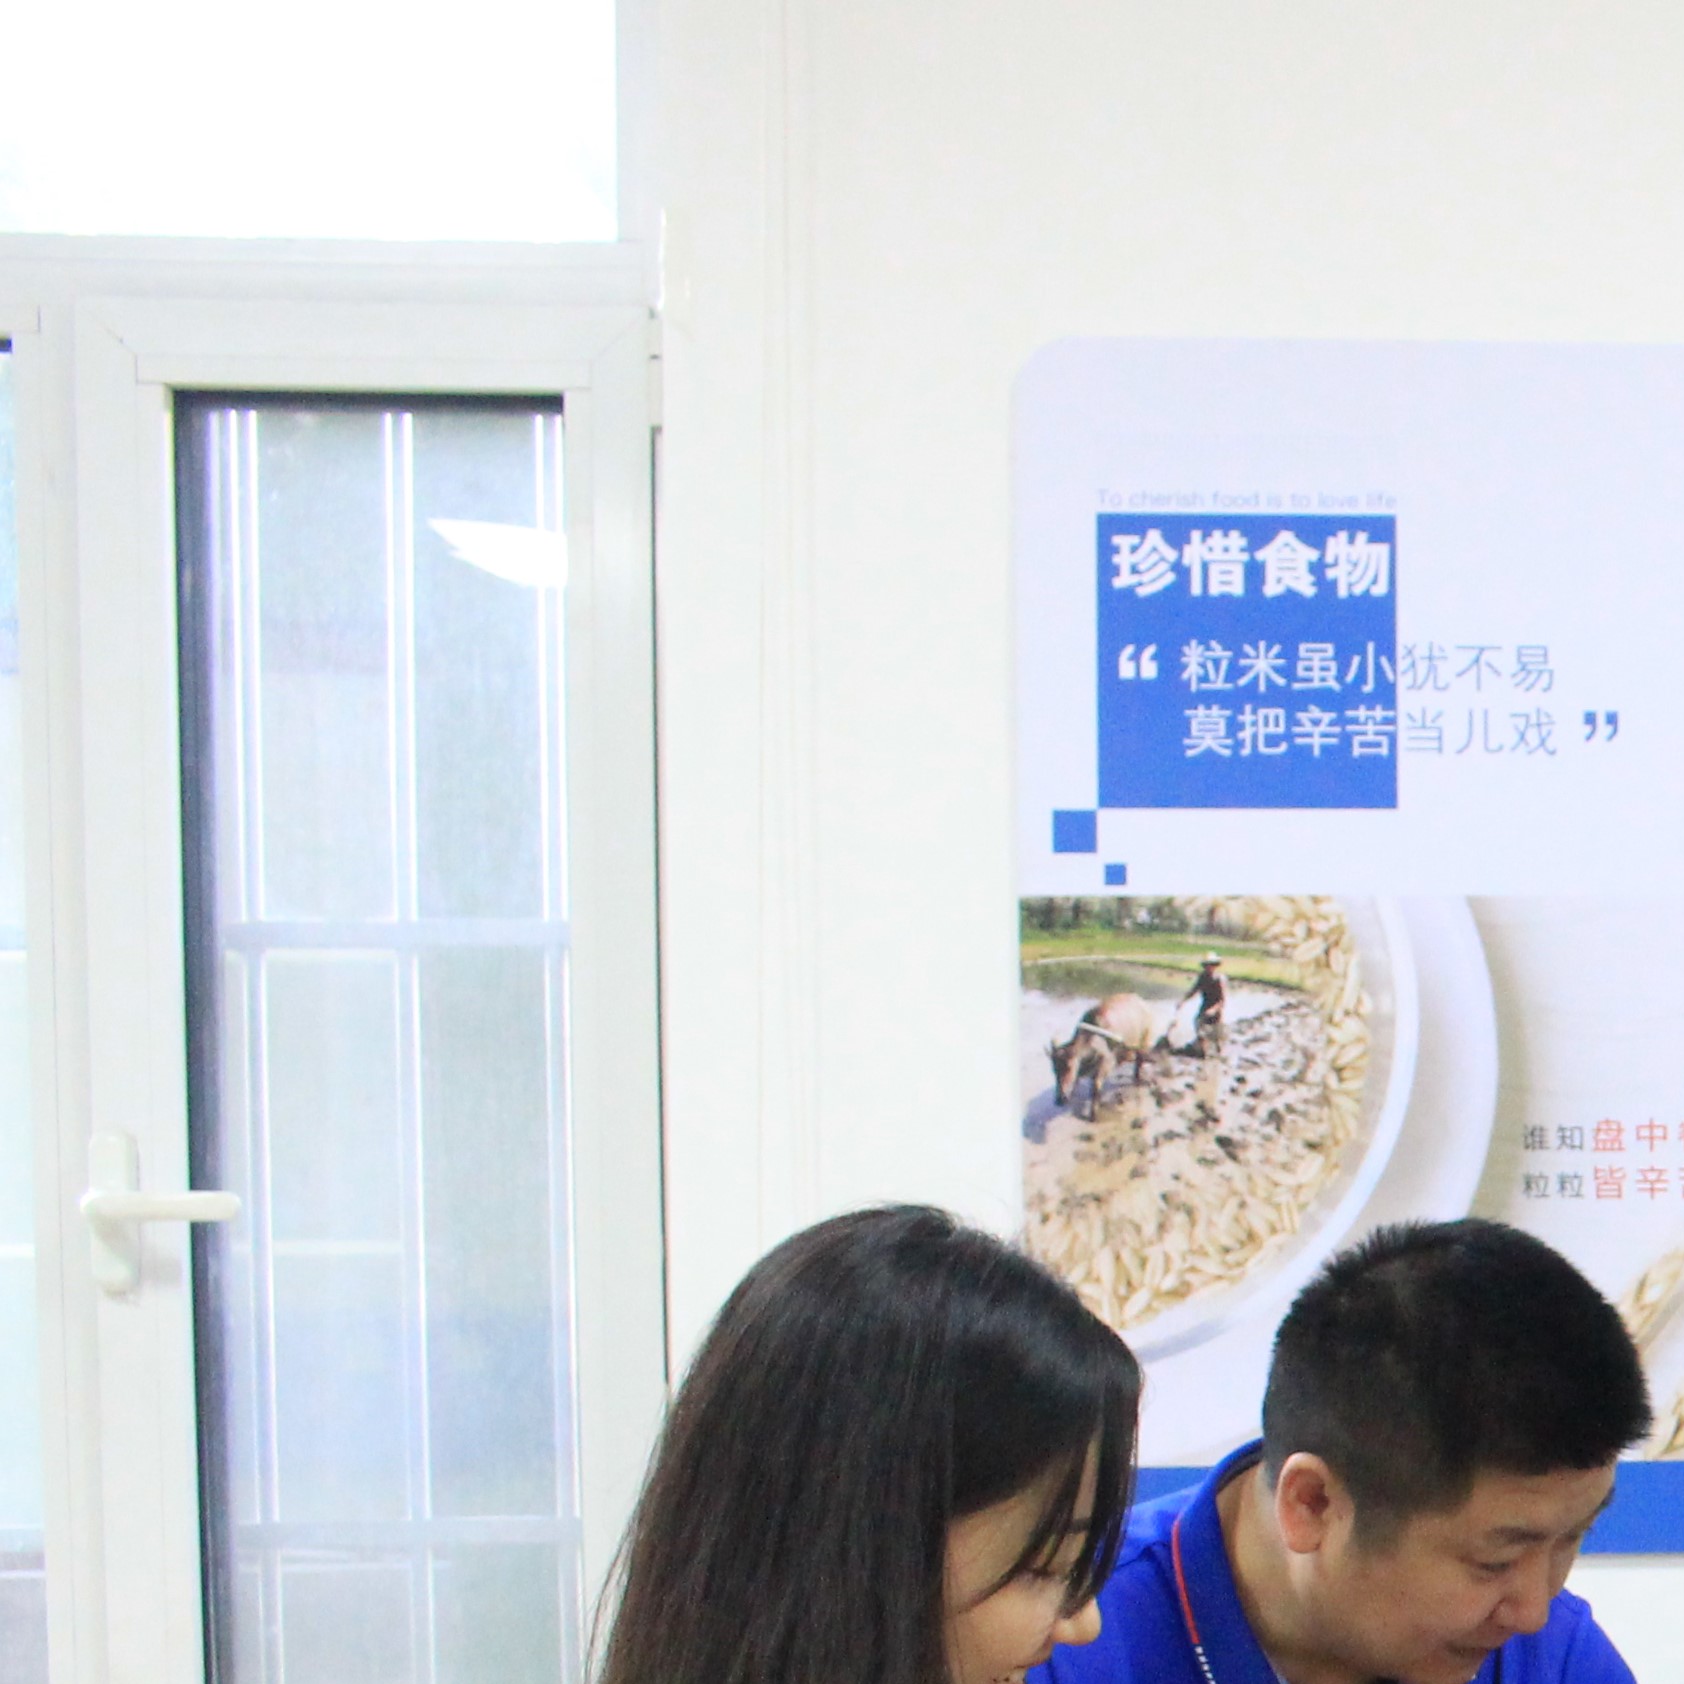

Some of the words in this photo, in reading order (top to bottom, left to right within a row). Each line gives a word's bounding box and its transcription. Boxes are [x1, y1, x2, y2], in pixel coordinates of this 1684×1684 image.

[1096, 488, 1123, 508] To
[1128, 489, 1206, 508] cherish
[1212, 490, 1261, 508] food
[1266, 491, 1283, 508] is
[1290, 491, 1311, 508] to
[1317, 491, 1360, 509] love
[1366, 491, 1398, 509] life
[1111, 529, 1391, 599] 珍惜食物
